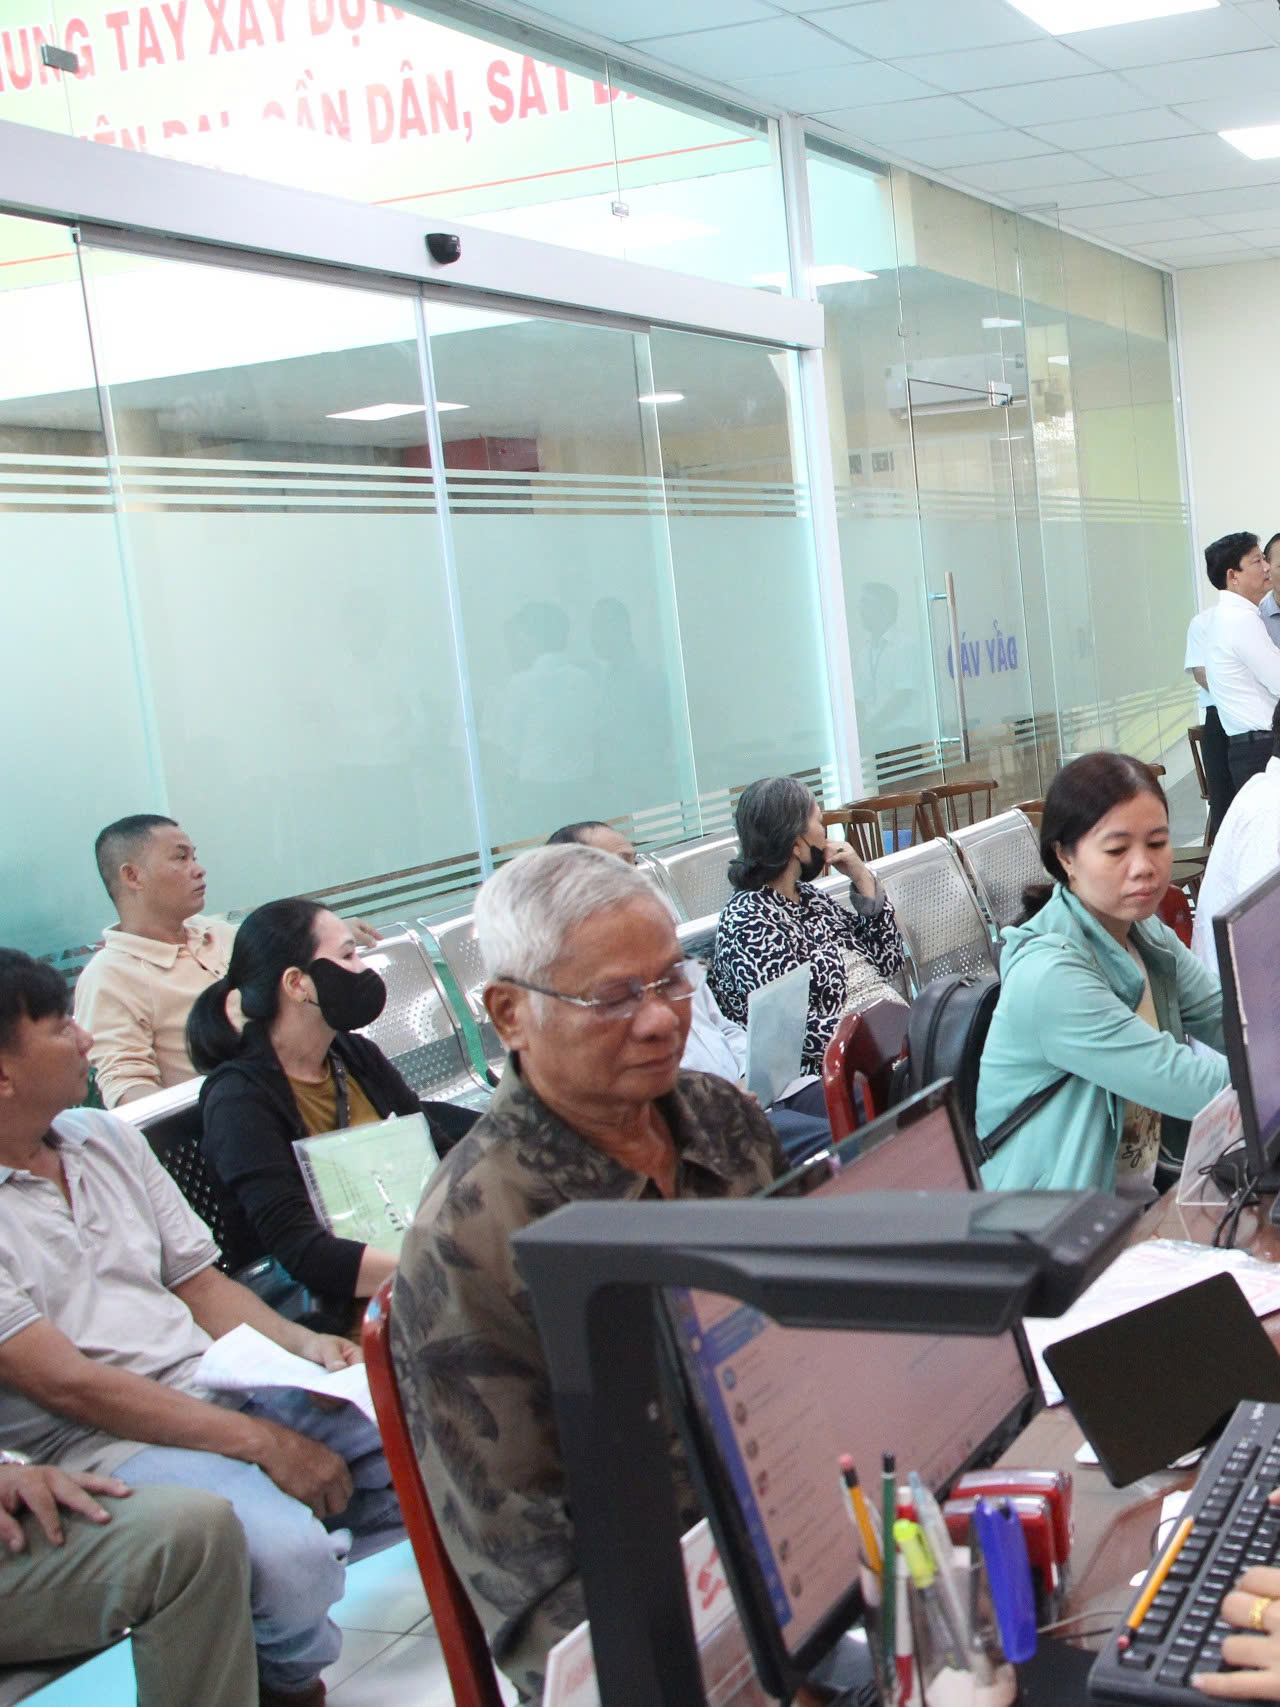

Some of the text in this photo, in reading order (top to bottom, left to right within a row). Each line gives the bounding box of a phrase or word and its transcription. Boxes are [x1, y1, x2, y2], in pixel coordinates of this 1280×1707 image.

[0, 18, 95, 92] UNG
[105, 0, 187, 72] TAY
[366, 59, 473, 145] DÂN,
